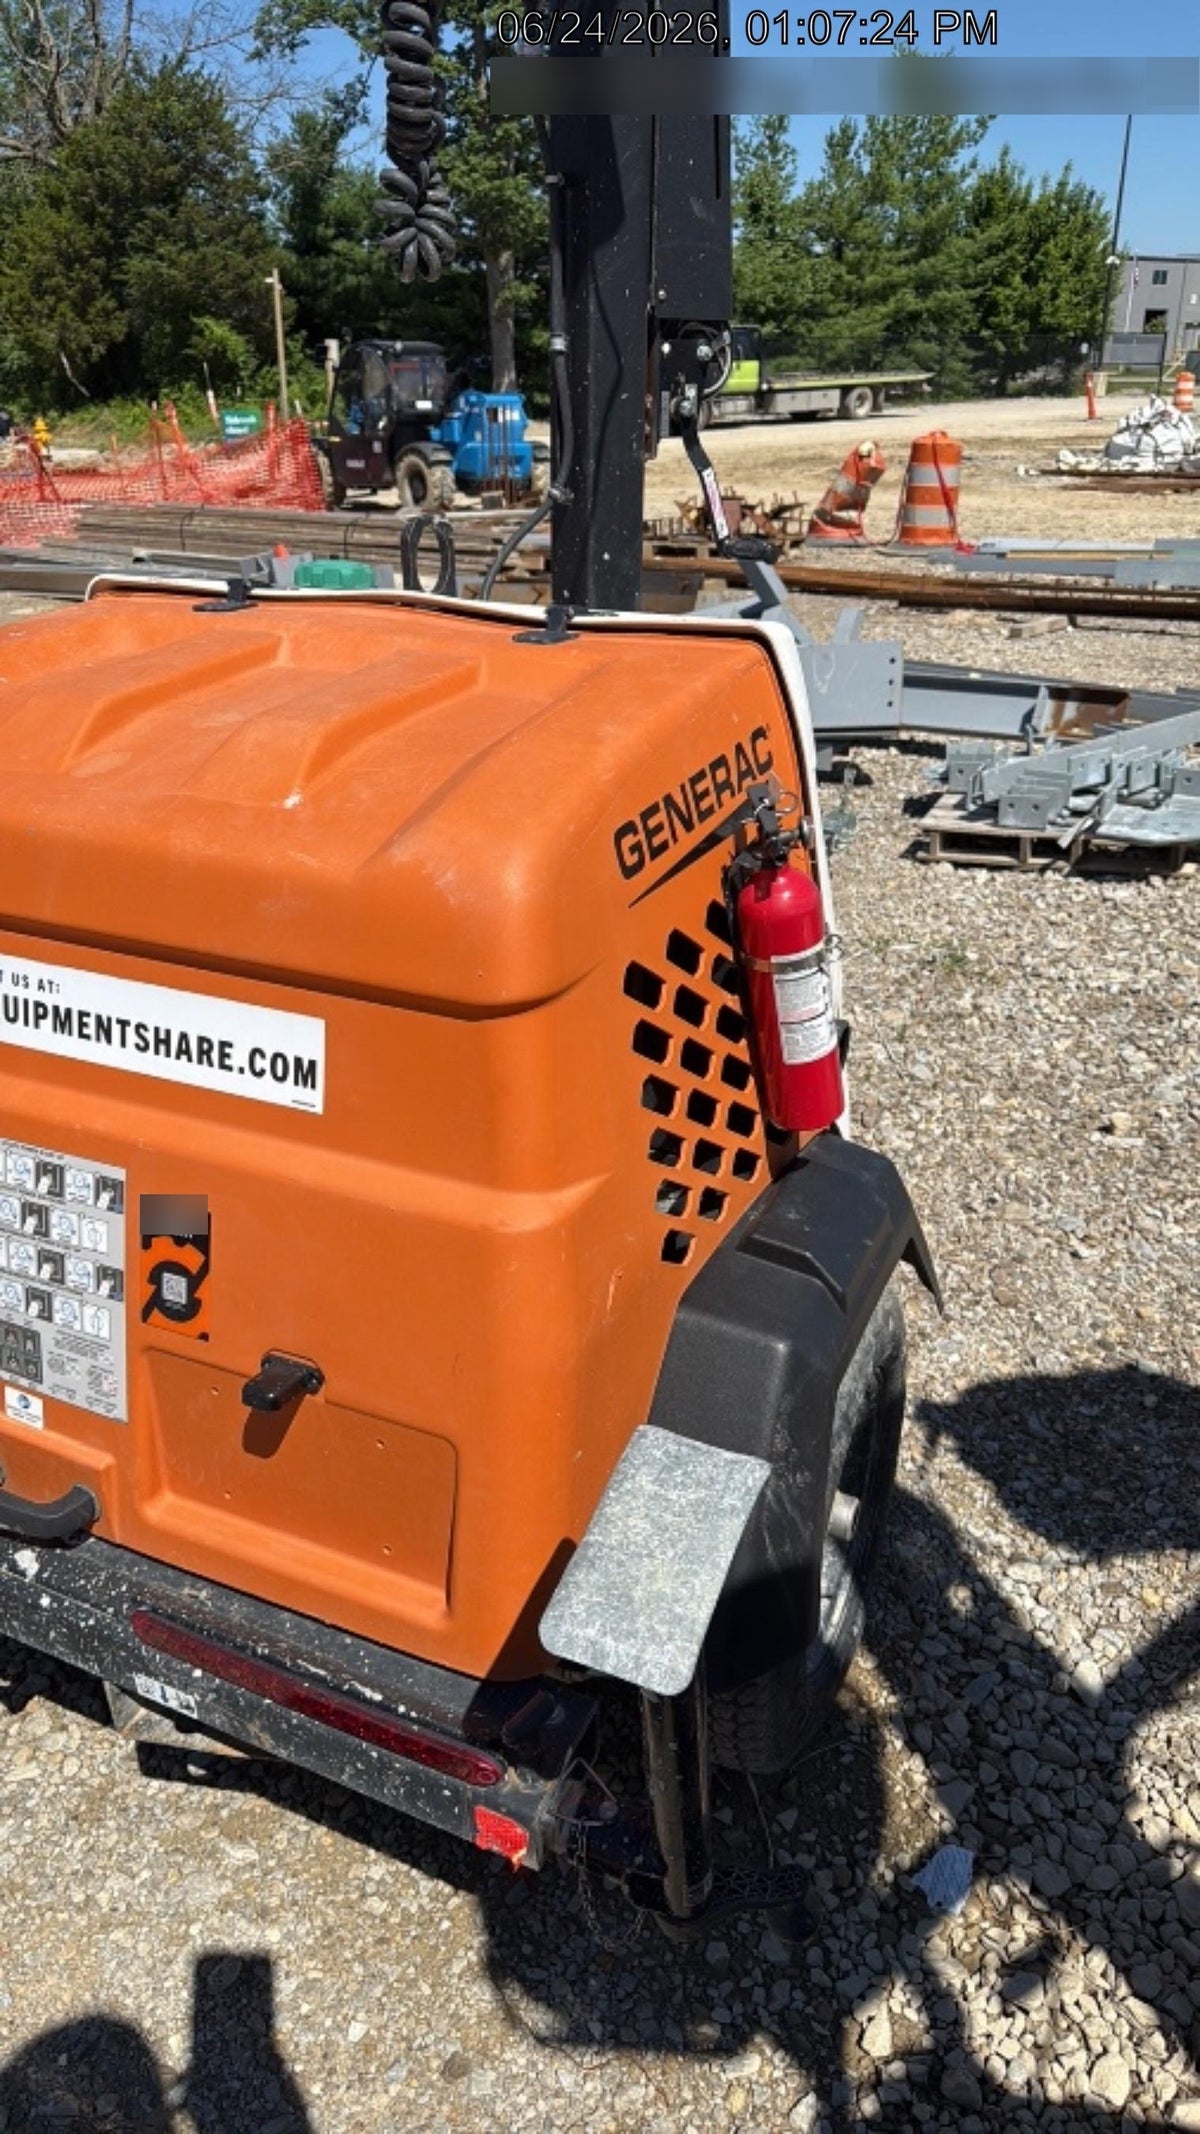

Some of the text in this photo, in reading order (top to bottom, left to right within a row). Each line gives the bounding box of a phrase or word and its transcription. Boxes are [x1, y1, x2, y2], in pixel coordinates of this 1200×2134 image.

[613, 725, 774, 880] GENERAC
[11, 971, 30, 990] US
[37, 978, 61, 995] AT:
